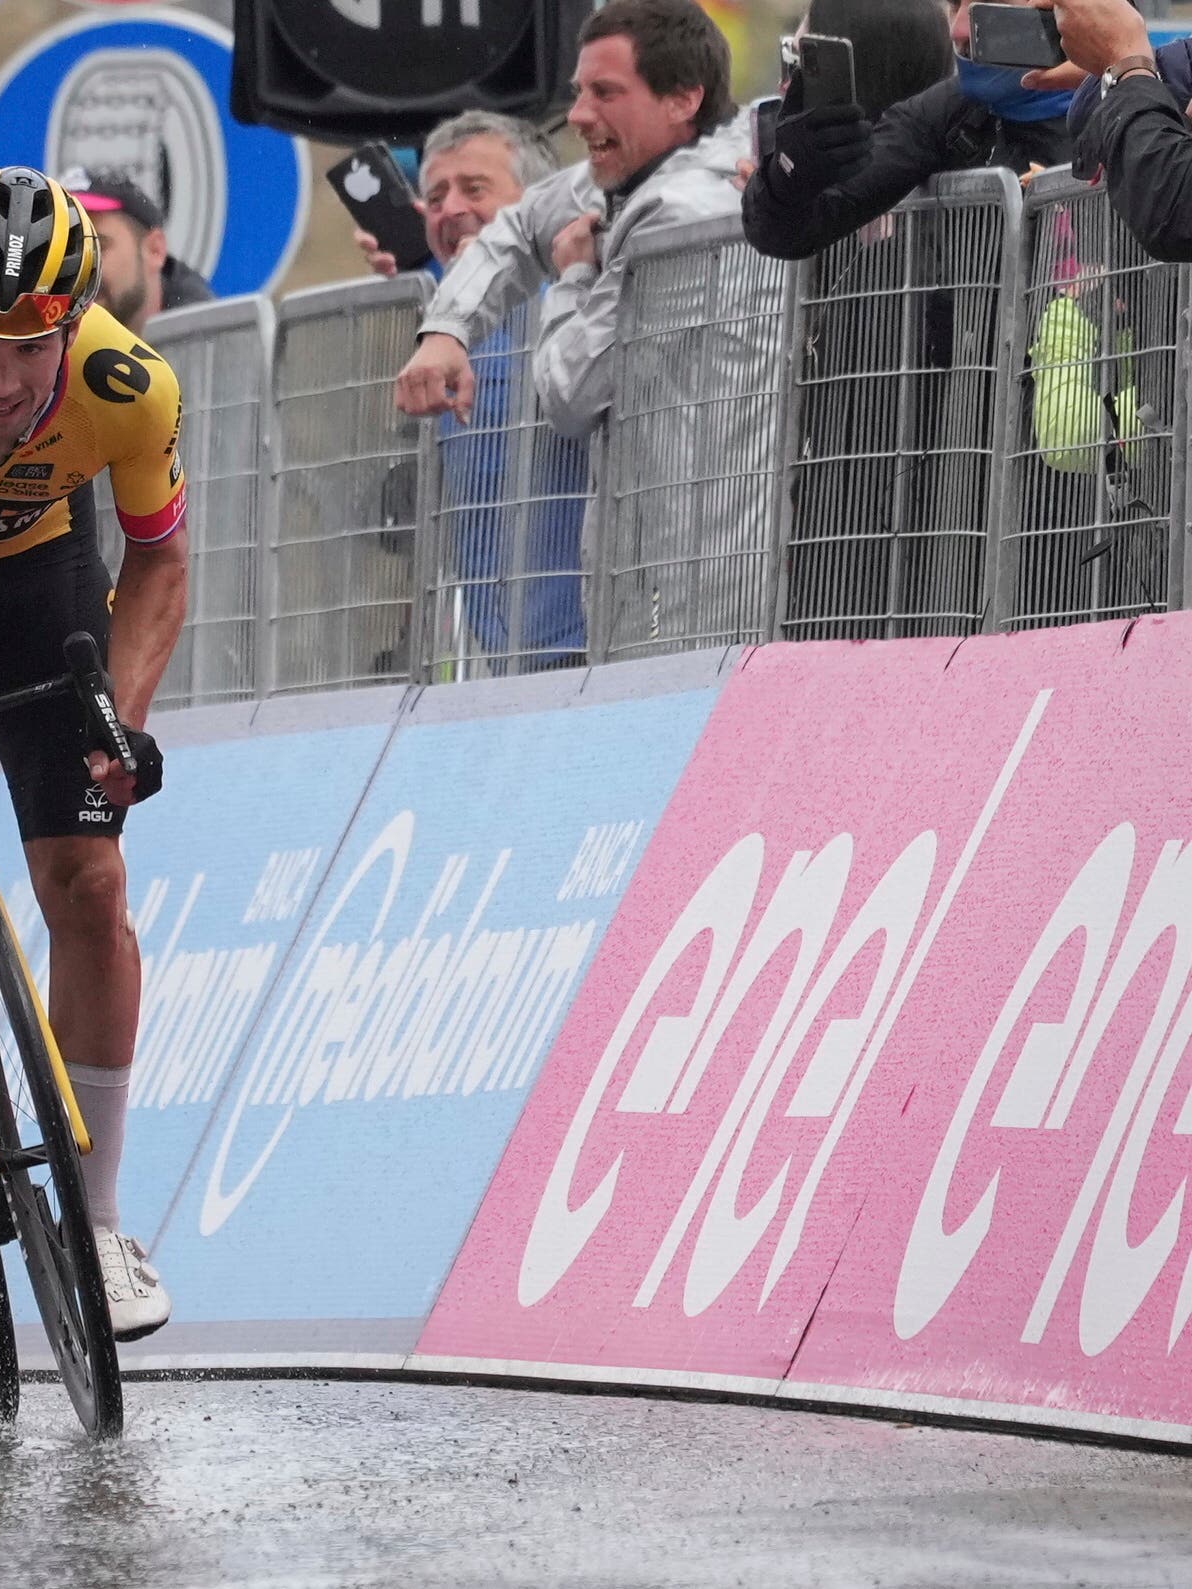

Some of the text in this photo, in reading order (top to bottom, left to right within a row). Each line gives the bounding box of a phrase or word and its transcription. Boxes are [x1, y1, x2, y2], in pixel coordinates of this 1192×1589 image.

[5, 234, 25, 278] PRIMOZ
[94, 693, 133, 759] SRAM
[78, 811, 114, 823] AGU
[556, 819, 645, 903] BANCA
[249, 848, 597, 1107] mediolanum
[516, 688, 1055, 1319] enel
